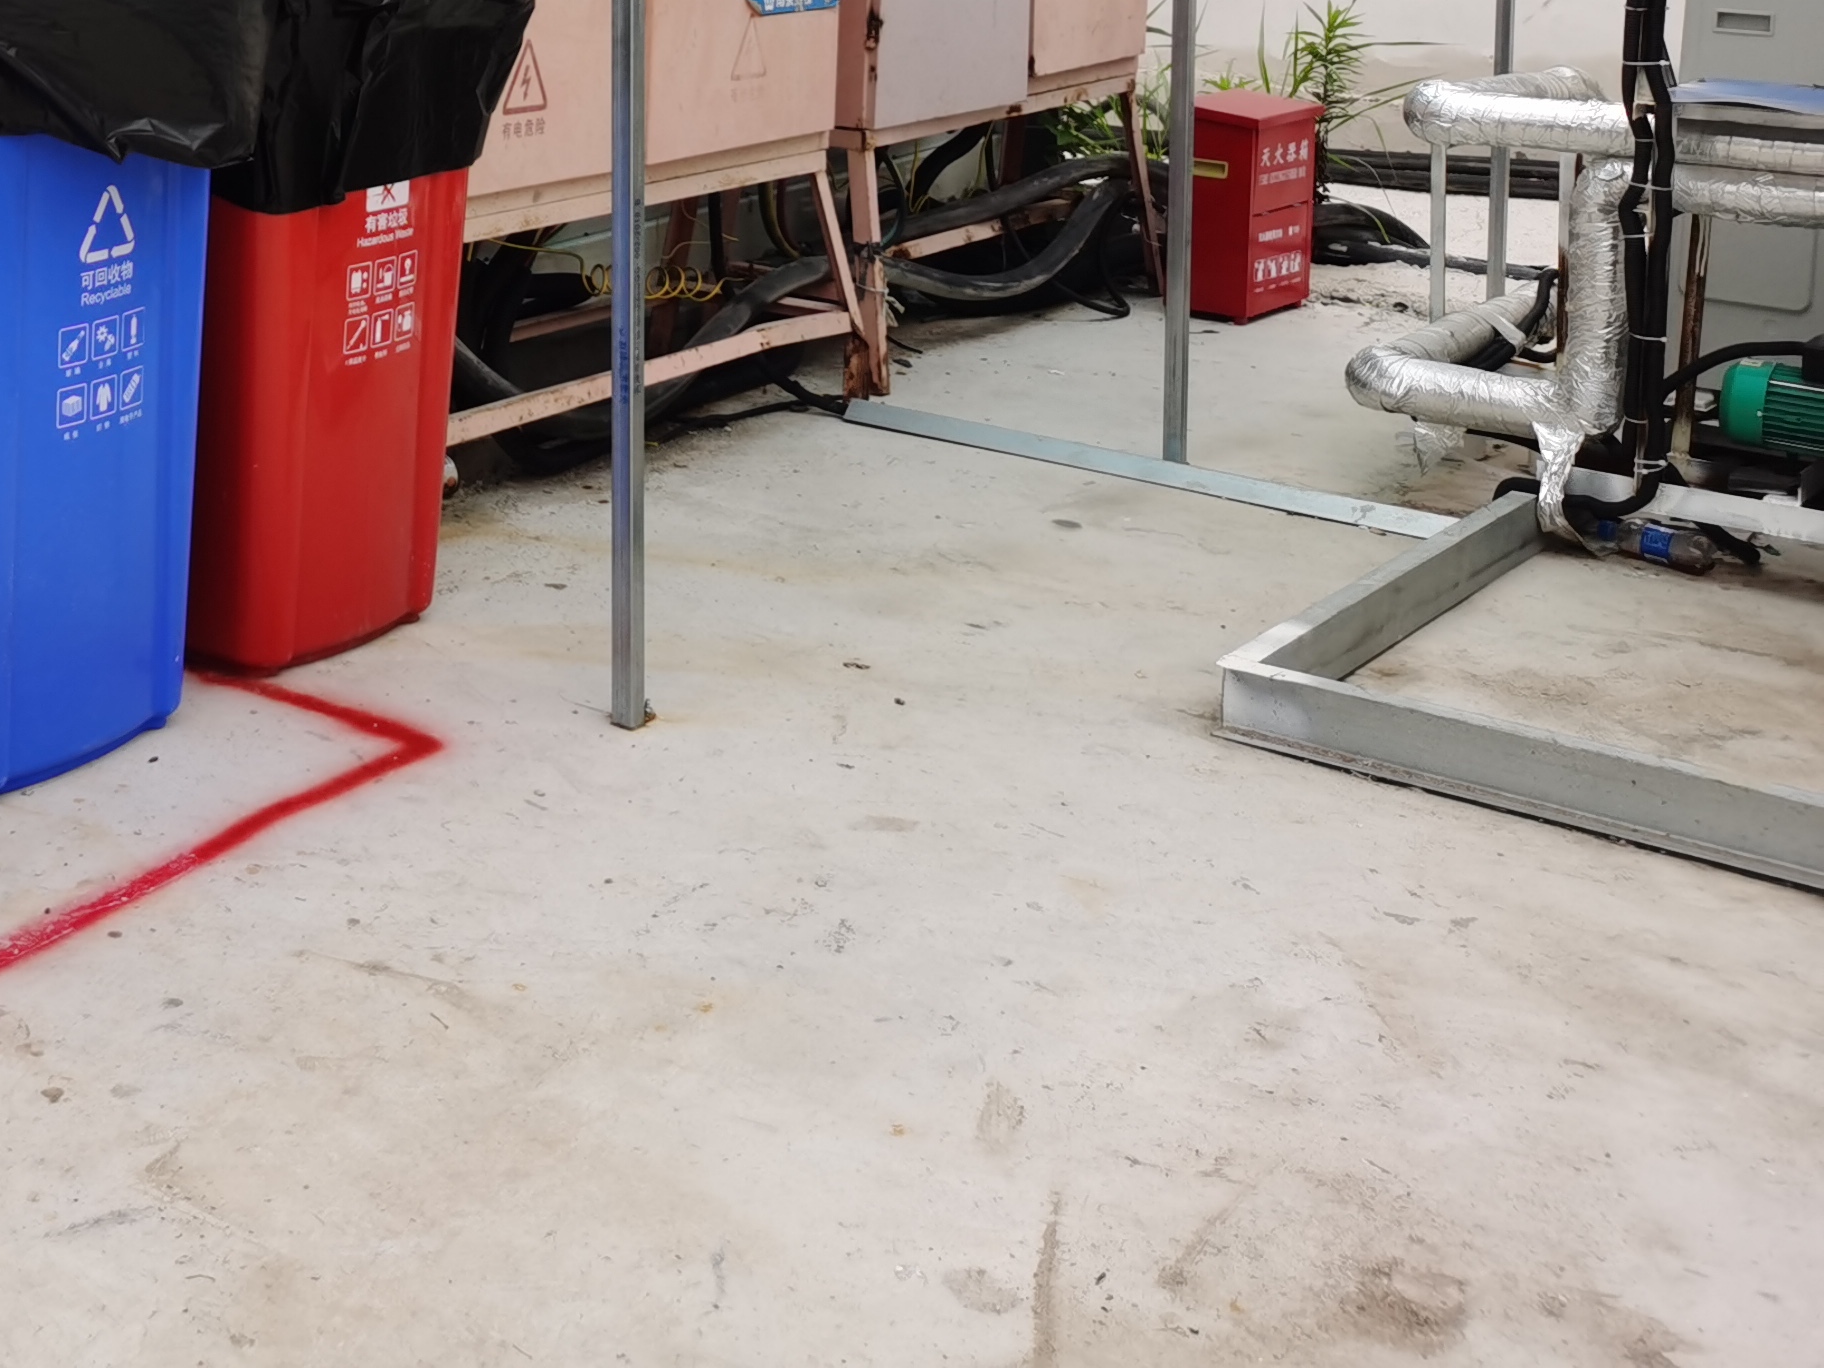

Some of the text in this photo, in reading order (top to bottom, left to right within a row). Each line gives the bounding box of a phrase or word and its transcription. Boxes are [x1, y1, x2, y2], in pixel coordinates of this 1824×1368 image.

[1260, 138, 1308, 166] 灭火器箱
[365, 207, 408, 234] 有害垃圾
[80, 260, 133, 290] 可回收物
[80, 282, 132, 307] Recyclable
